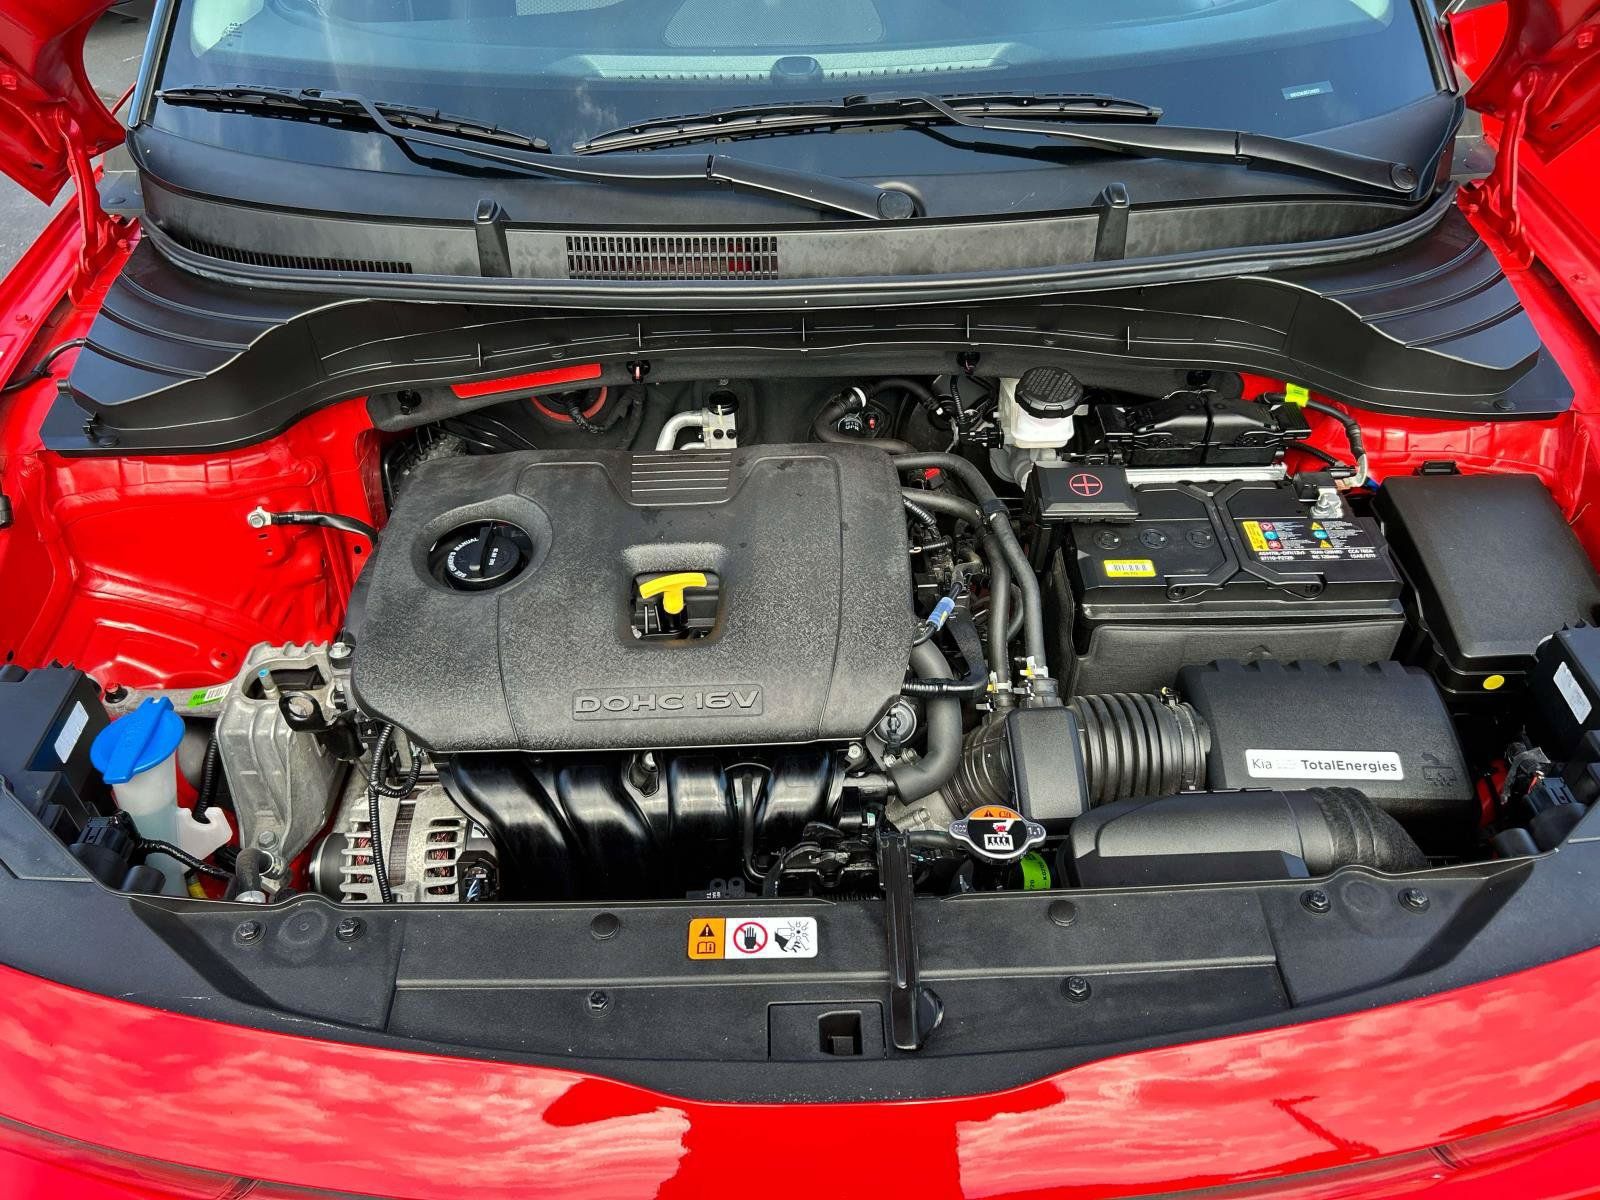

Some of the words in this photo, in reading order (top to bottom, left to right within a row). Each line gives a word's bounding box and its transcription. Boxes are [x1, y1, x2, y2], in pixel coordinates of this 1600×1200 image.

[453, 537, 479, 551] MANUAL
[575, 693, 685, 713] DOHC
[694, 690, 760, 710] 16V
[1252, 758, 1273, 770] Kia
[1300, 759, 1398, 774] TotalEnergies
